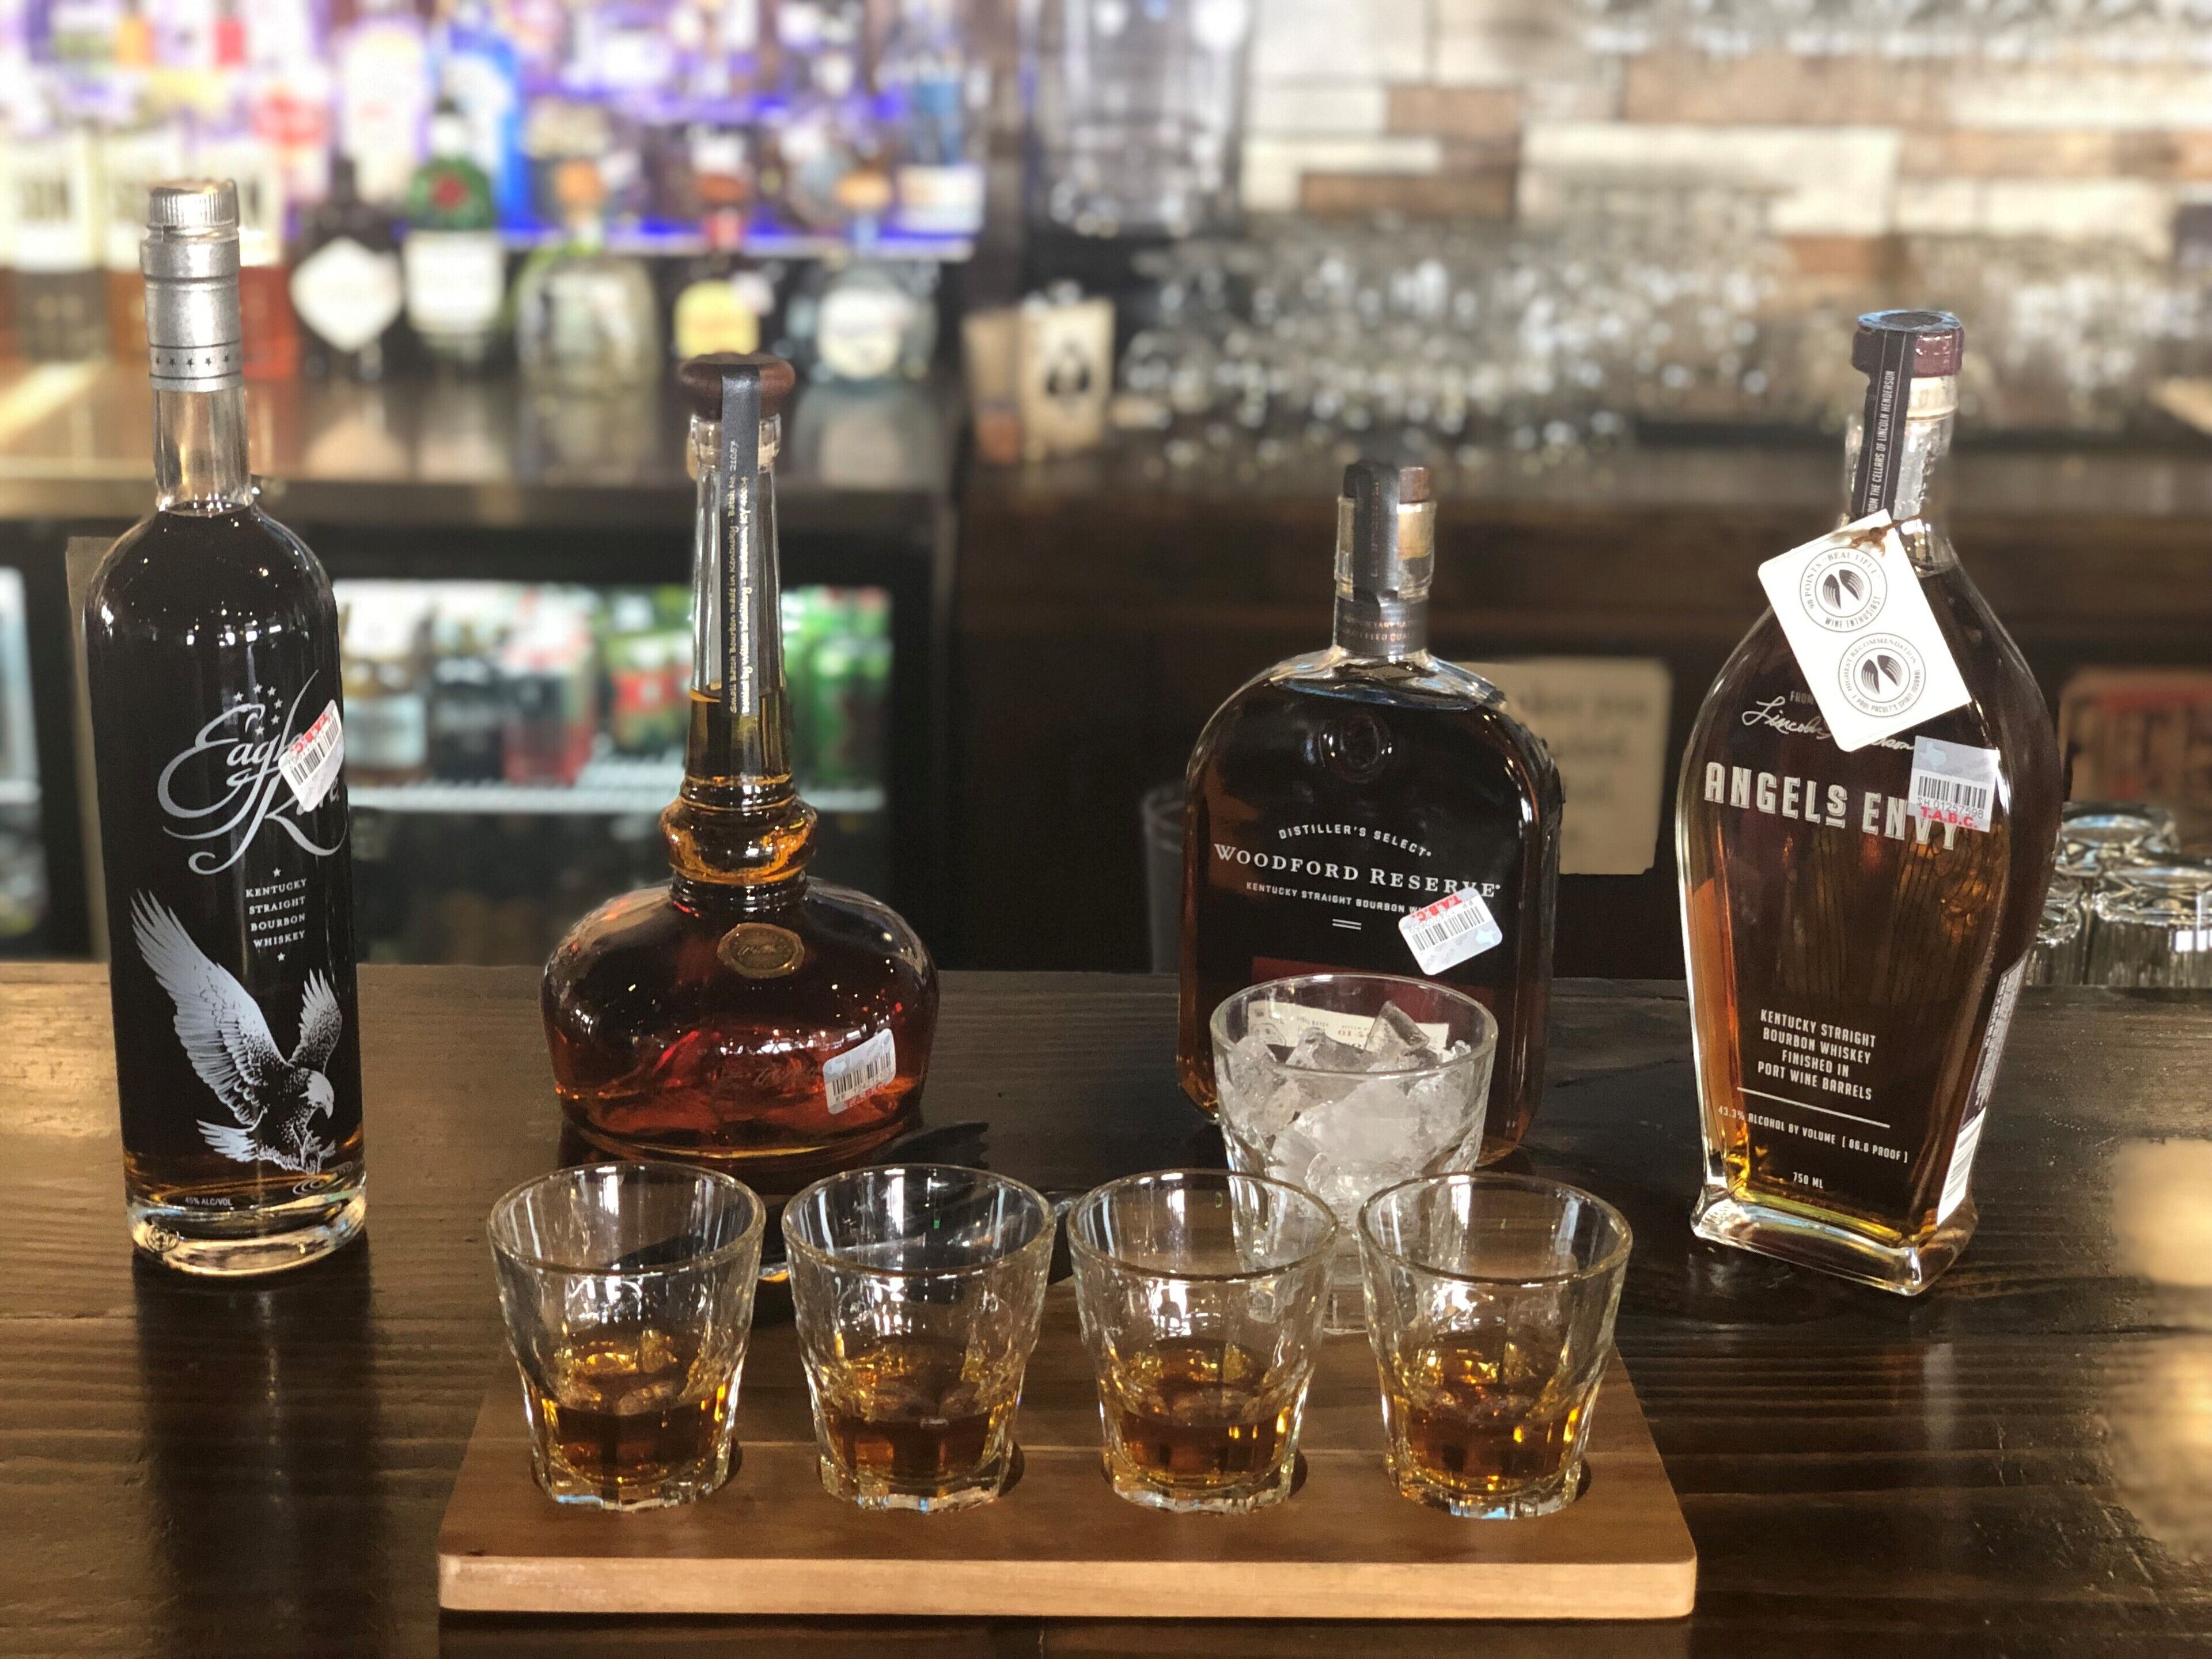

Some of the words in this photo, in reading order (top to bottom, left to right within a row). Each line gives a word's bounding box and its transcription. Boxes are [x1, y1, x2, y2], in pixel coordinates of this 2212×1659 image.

[1880, 370, 1895, 412] HENDERSON
[1877, 413, 1889, 441] LINCOLN
[1876, 442, 1886, 452] OF
[1872, 452, 1885, 483] CELLARS
[1870, 483, 1881, 496] THE
[1868, 498, 1878, 515] ROM
[1805, 563, 1821, 597] POINTS
[1825, 617, 1843, 628] WINE
[1846, 596, 1882, 628] ENTHUSIAST
[1843, 658, 1853, 692] HIGHEST
[1850, 638, 1916, 664] RECOMMENDATION
[1921, 806, 1978, 828] T.A.B.C.
[1278, 824, 1366, 839] DISTILLER'S
[1214, 843, 1359, 881] WOODFORD
[245, 878, 307, 897] KENTUCKY
[1246, 881, 1297, 897] KENTUCKY
[1301, 891, 1352, 905] STRAIGHT
[1355, 899, 1405, 913] BOURBON
[249, 896, 306, 915] STRAIGHT
[251, 912, 305, 931] BOURBON
[253, 930, 305, 948] WHISKEY
[1760, 1009, 1816, 1033] KENTUCKY
[1821, 1024, 1876, 1048] STRAIGHT
[1763, 1027, 1815, 1051] BOURBON
[1820, 1041, 1871, 1064] WHISKEY
[1782, 1050, 1832, 1073] FINISHED
[1838, 1063, 1849, 1077] IN
[1758, 1061, 1785, 1079] PORT
[1790, 1069, 1817, 1087] WINE
[1822, 1077, 1872, 1101] BARRELS
[1718, 1105, 1745, 1121] 43.3%
[1748, 1113, 1785, 1132] ALCOHOL
[1789, 1123, 1799, 1135] BY
[1802, 1127, 1836, 1145] VOLUME
[1872, 1145, 1901, 1160] PROOF
[1793, 1172, 1809, 1184] 750
[1812, 1177, 1824, 1189] ML
